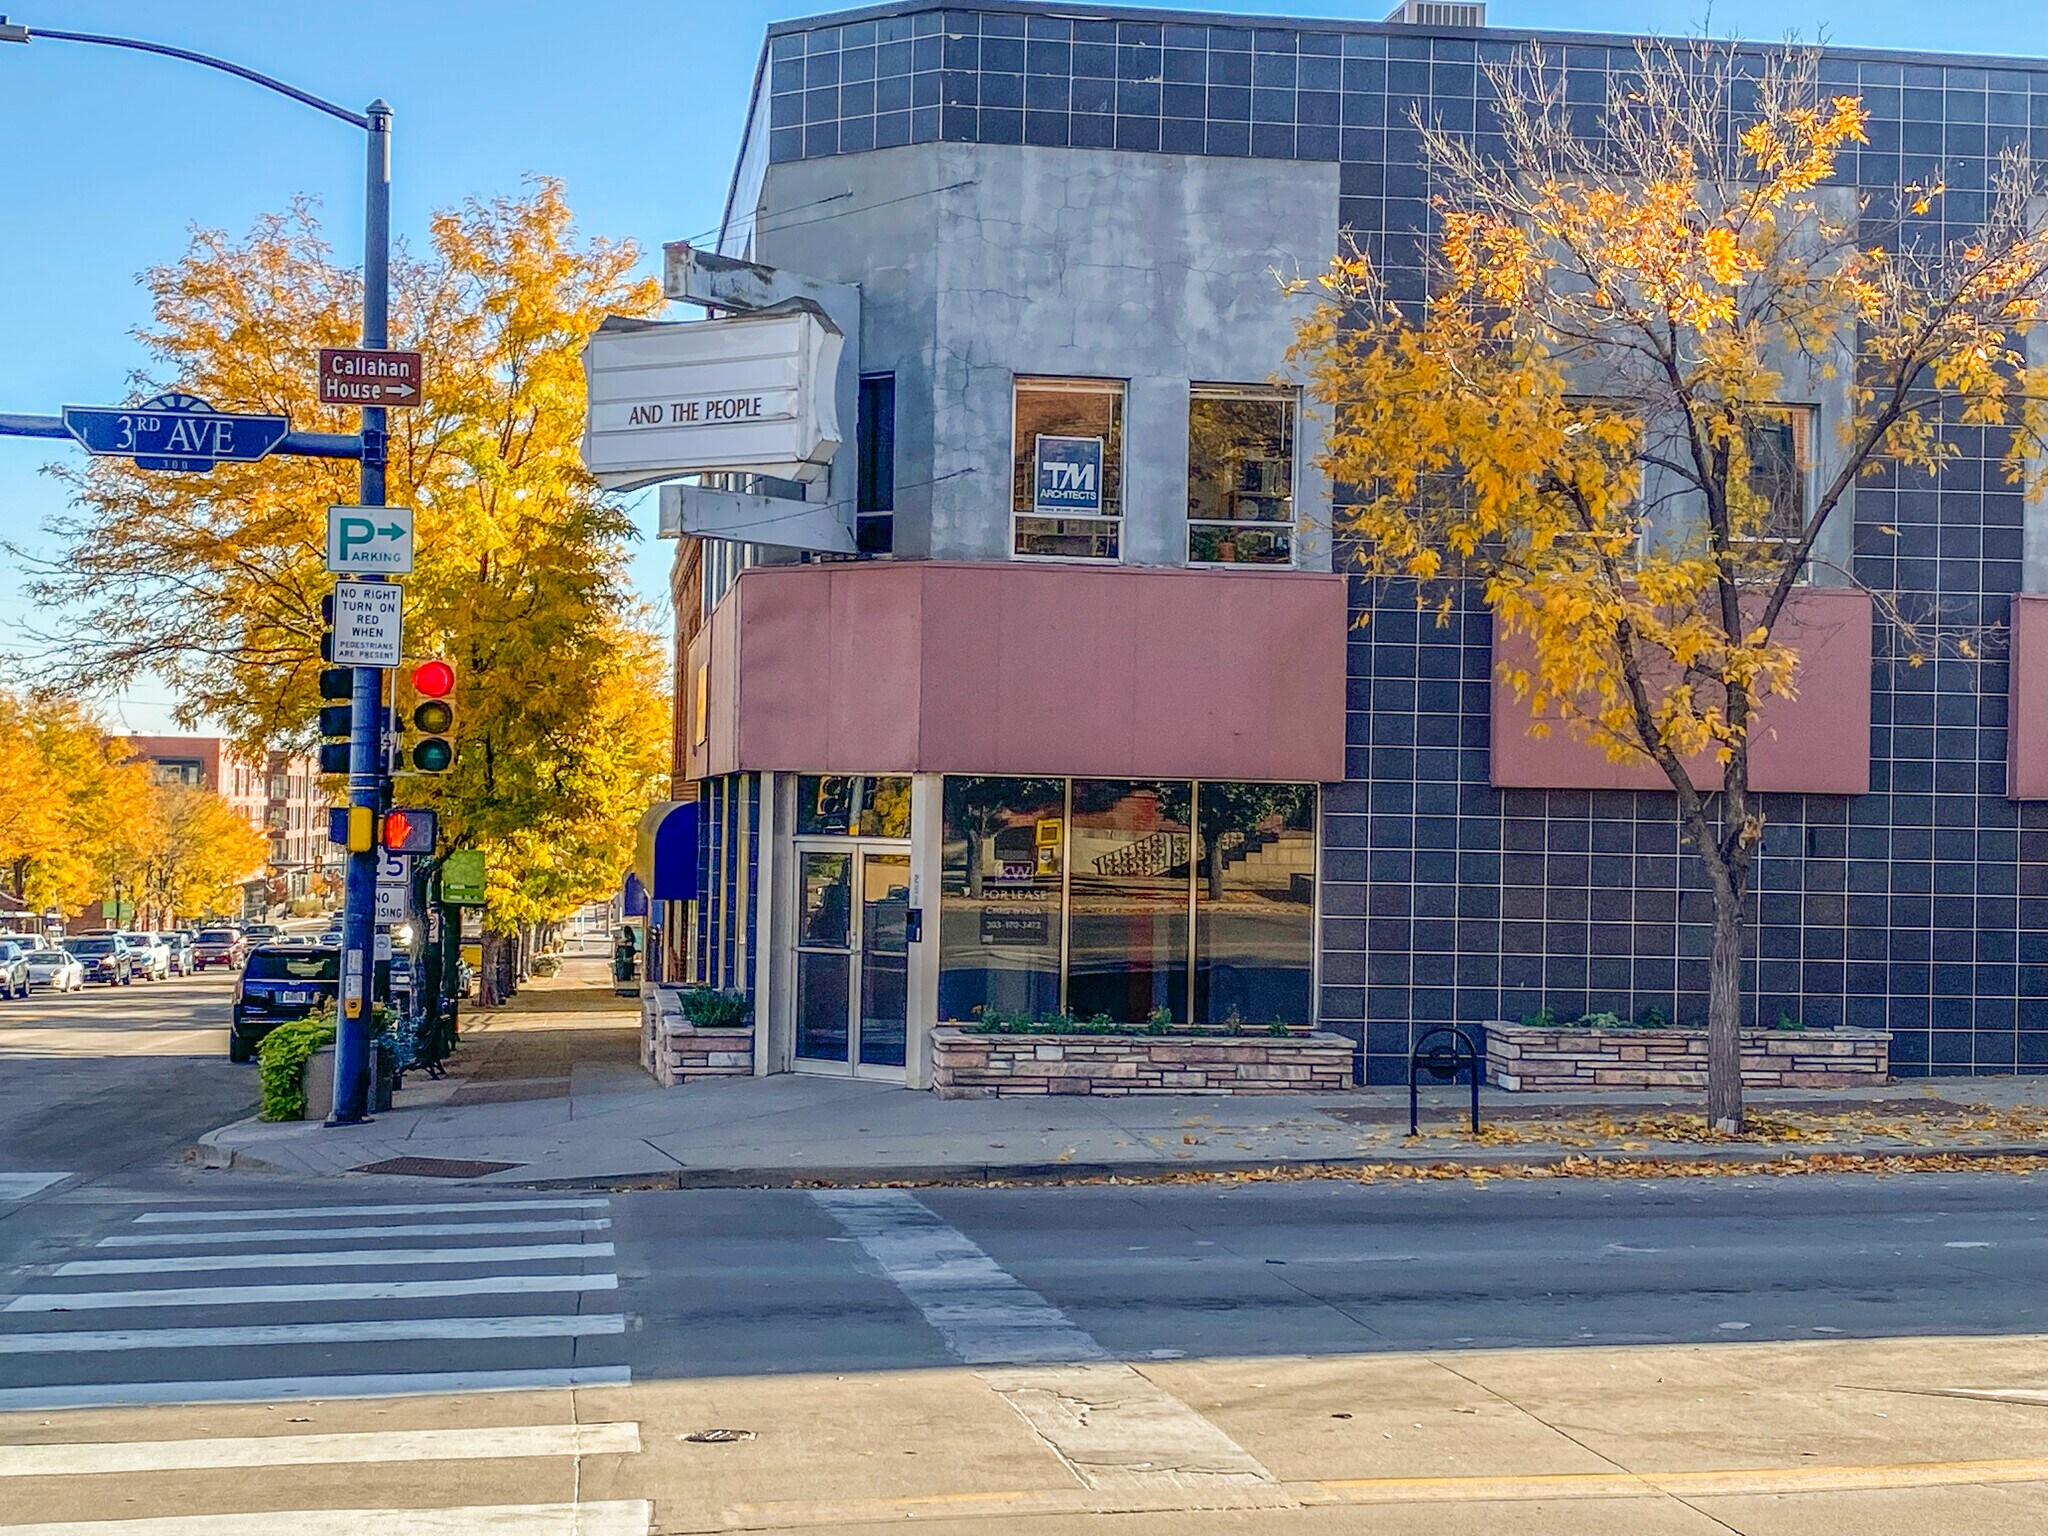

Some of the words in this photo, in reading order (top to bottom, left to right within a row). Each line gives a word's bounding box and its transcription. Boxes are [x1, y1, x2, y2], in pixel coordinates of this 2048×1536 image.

[332, 355, 410, 377] Callahan
[326, 378, 381, 399] House
[628, 404, 664, 426] AND
[670, 401, 700, 423] THE
[705, 397, 762, 420] PEOPLE
[116, 415, 161, 449] 3RD
[164, 418, 235, 453] AVE
[1043, 461, 1095, 491] TM
[1040, 488, 1097, 500] ARCHITECTS
[341, 588, 357, 599] NO
[363, 589, 397, 600] RIGHT
[343, 601, 372, 612] TURN
[379, 602, 395, 613] ON
[356, 614, 379, 625] RED
[352, 627, 384, 638] WHEN
[340, 640, 393, 650] PEDESTRIANS
[338, 650, 355, 658] ARE
[359, 651, 393, 659] PRESENT
[982, 889, 1007, 900] FOR
[1011, 890, 1047, 900] LEASE
